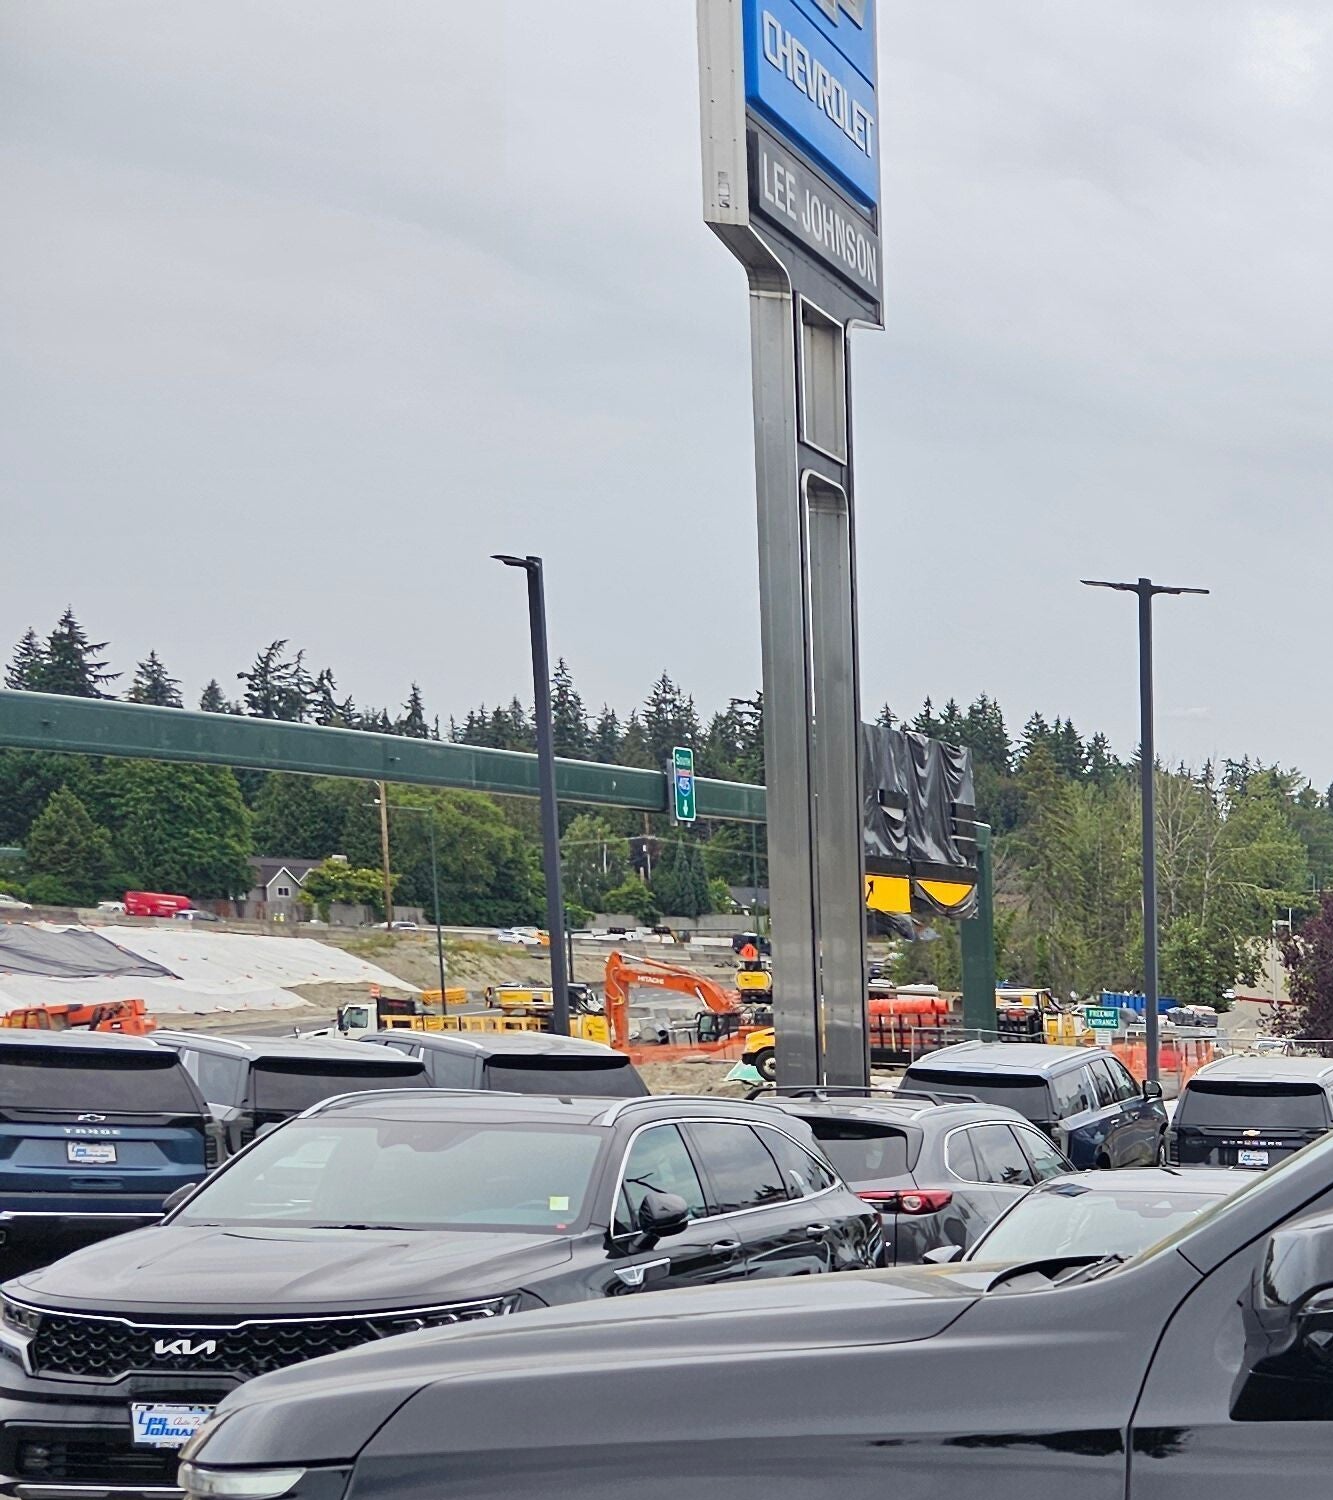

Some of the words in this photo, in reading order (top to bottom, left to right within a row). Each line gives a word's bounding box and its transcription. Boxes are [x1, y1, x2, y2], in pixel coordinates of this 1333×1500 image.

[762, 9, 876, 158] CHEVROLET
[763, 151, 798, 221] LEE
[801, 189, 878, 287] JOHNSON
[637, 975, 665, 985] HITACHI
[154, 1339, 217, 1355] KIA
[138, 1411, 168, 1425] Lee
[141, 1420, 198, 1437] Johns
